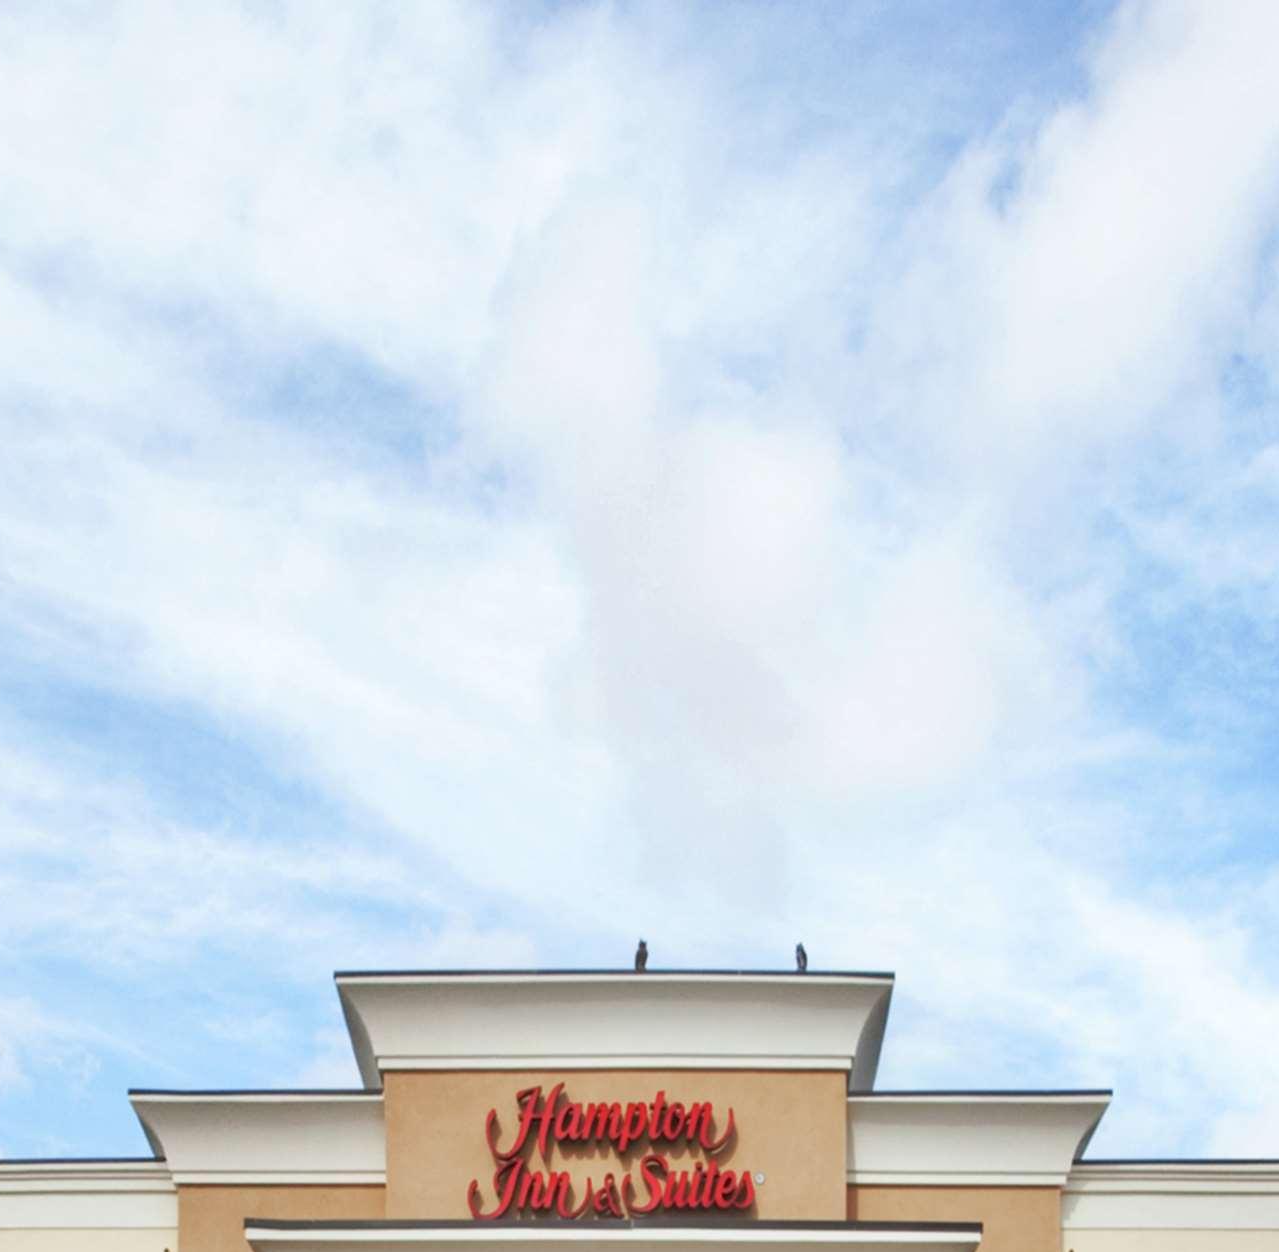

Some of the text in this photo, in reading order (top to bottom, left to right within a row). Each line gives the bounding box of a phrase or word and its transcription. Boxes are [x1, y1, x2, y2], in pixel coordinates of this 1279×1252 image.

[486, 1082, 734, 1161] Hampton
[468, 1154, 755, 1219] Inn & Suites
